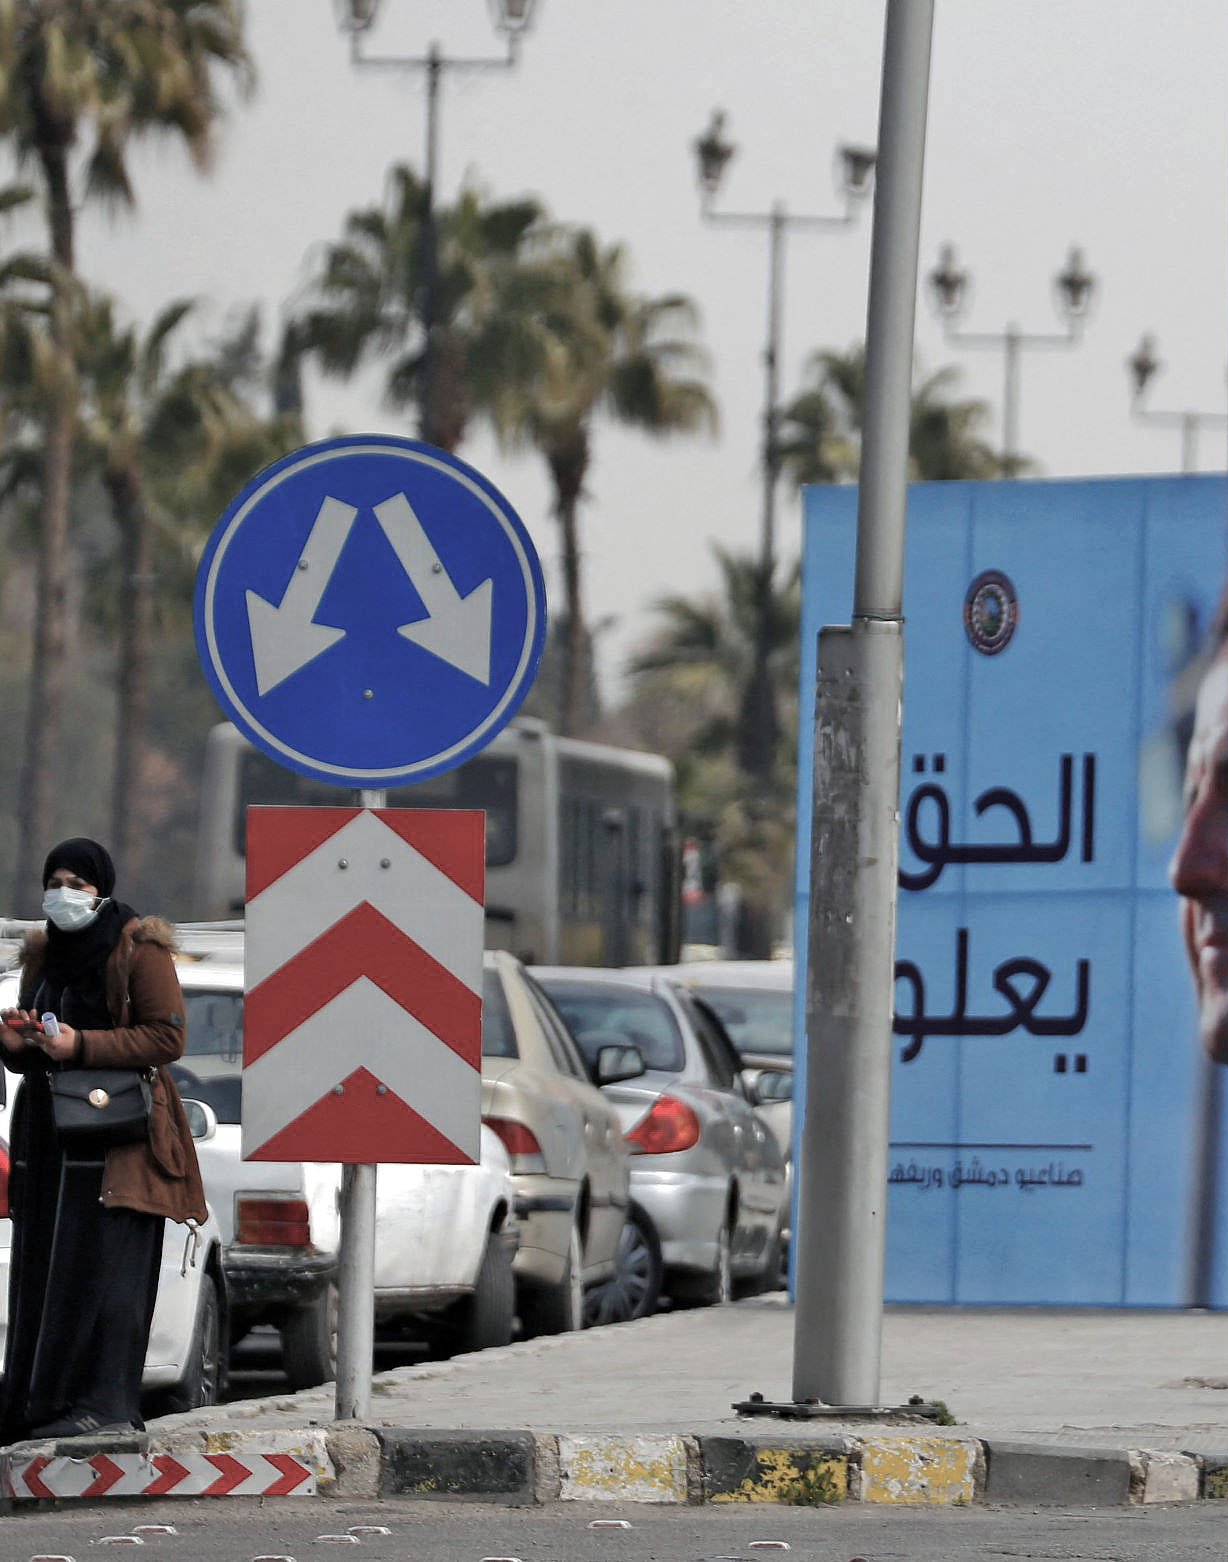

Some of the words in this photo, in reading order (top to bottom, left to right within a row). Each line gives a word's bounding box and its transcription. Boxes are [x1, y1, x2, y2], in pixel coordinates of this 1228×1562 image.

[898, 752, 1096, 892] الحق
[893, 926, 1091, 1074] يعلو
[888, 1158, 943, 1190] وريفه
[948, 1155, 1009, 1189] دمشق
